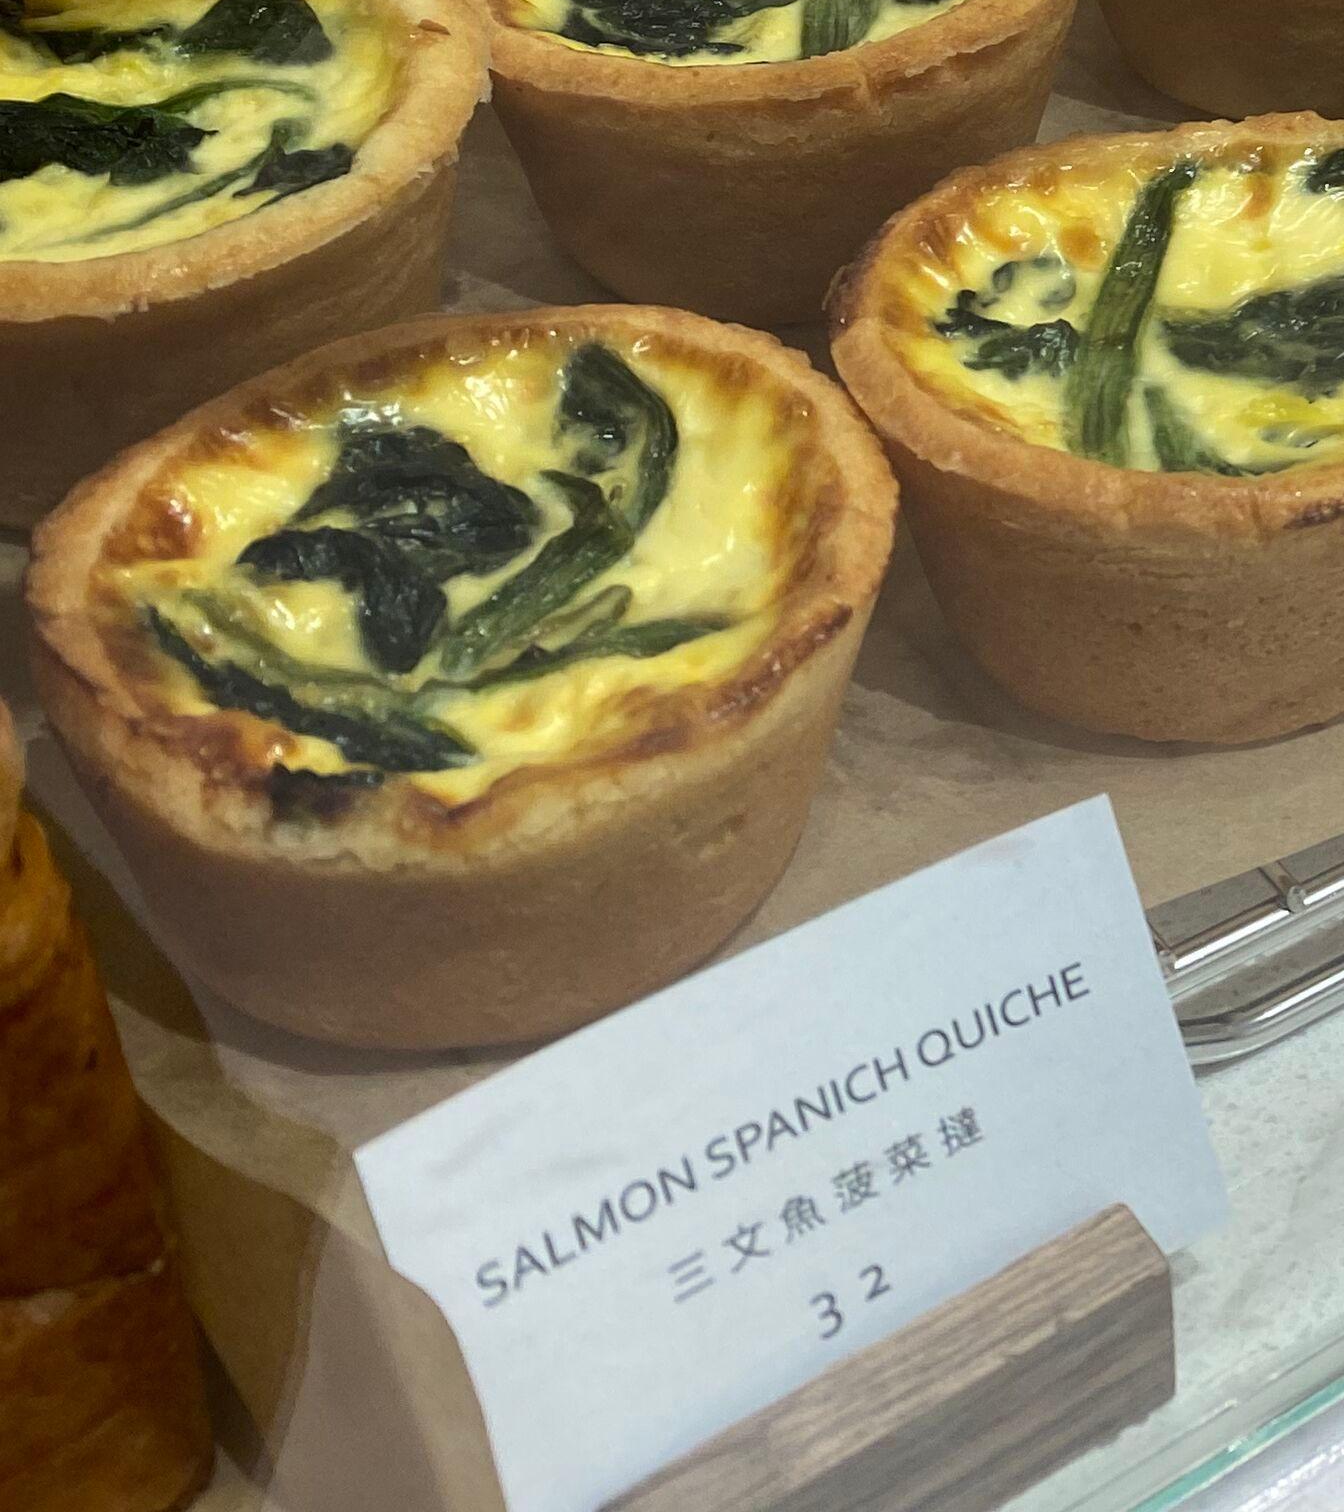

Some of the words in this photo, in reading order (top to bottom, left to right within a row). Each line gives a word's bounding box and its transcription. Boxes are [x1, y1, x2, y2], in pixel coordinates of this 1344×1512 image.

[475, 1155, 699, 1309] SALMON
[704, 1047, 910, 1180] SPANICH
[917, 962, 1091, 1068] QUICHE
[667, 1107, 985, 1303] 三文魚菠菜撻
